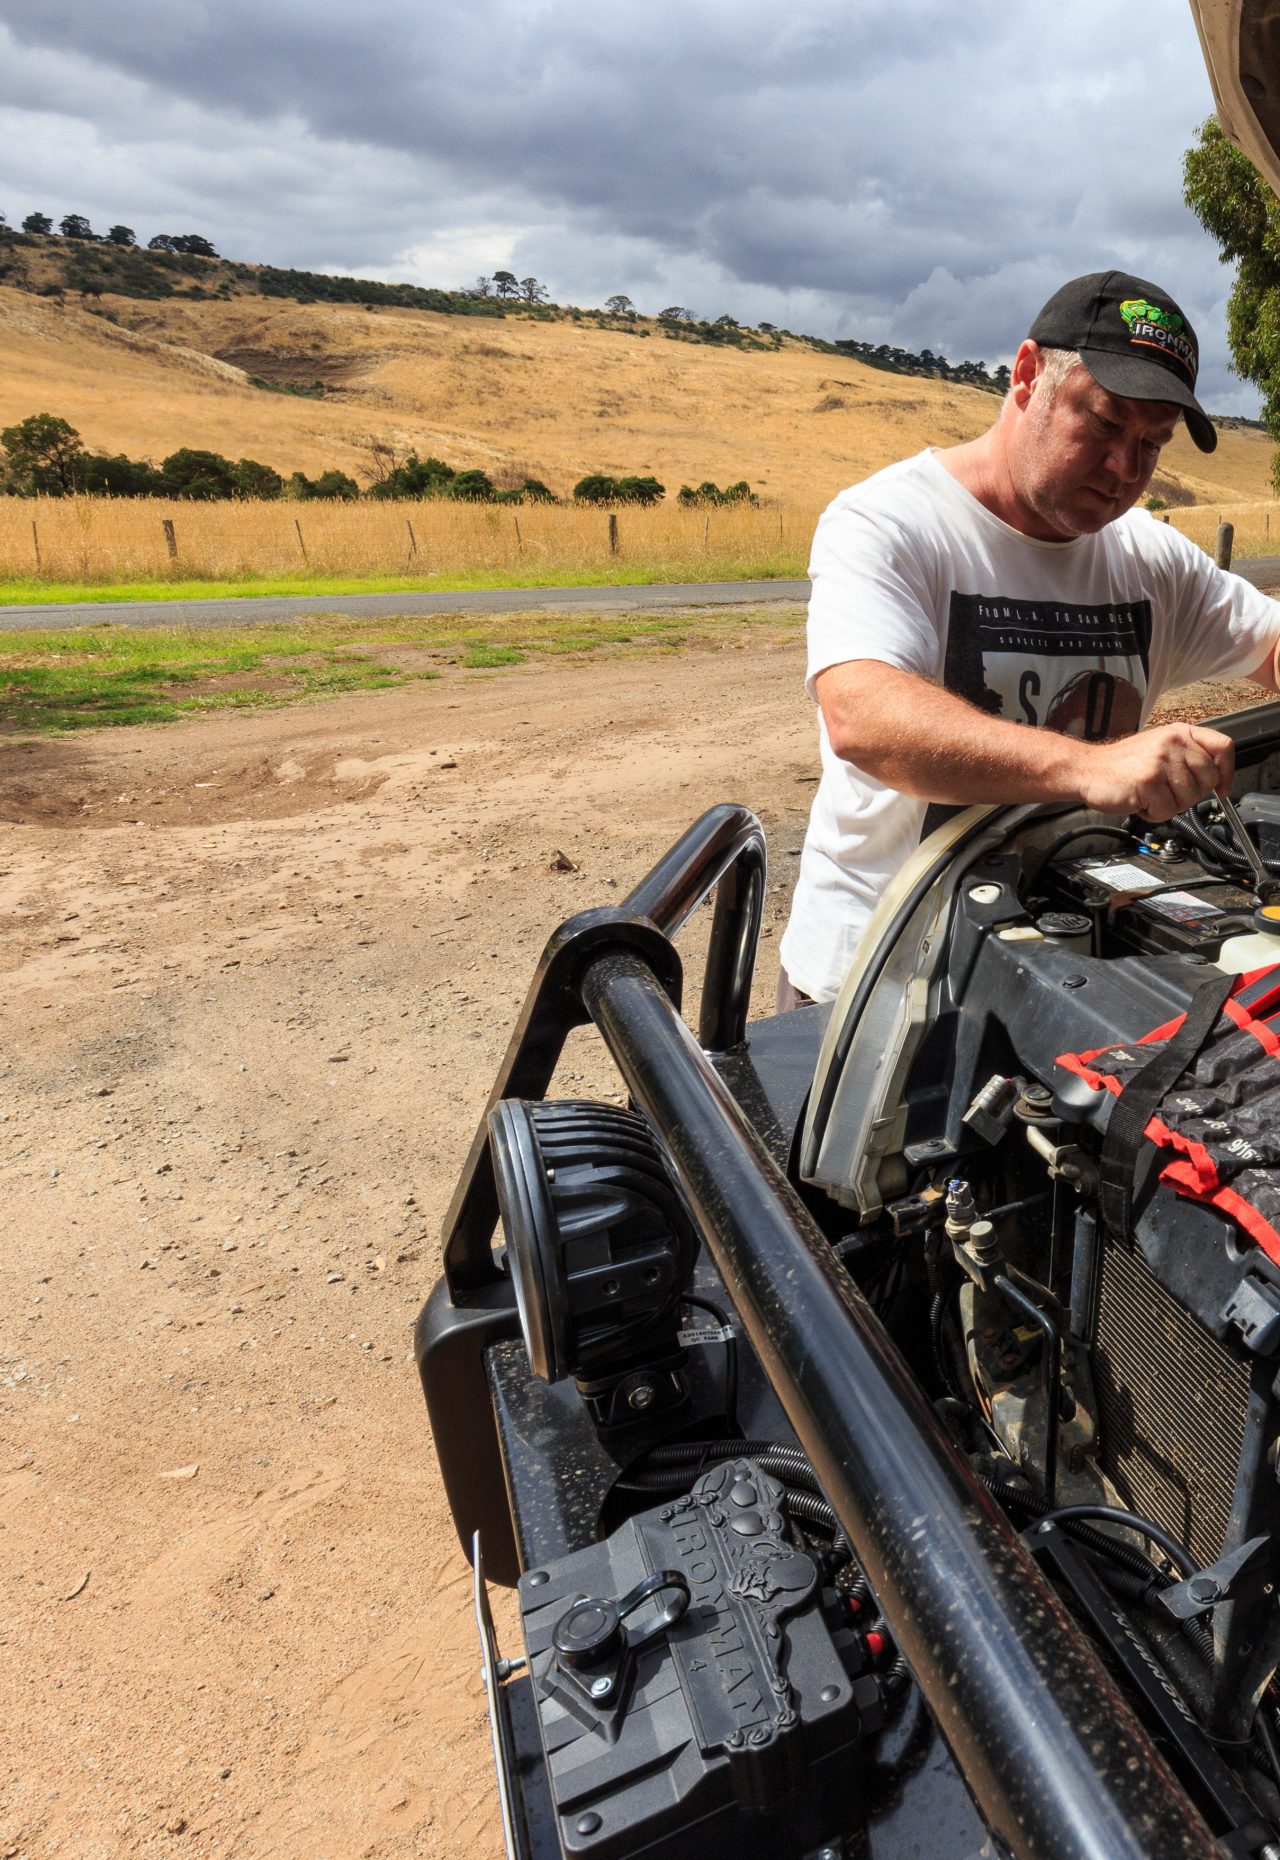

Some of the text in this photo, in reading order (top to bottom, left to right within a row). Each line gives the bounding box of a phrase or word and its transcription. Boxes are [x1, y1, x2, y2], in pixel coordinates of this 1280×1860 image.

[1055, 611, 1070, 623] TO
[1078, 614, 1099, 625] SAN
[1176, 1098, 1204, 1115] 3/4"
[1228, 1139, 1263, 1162] 9/16"
[669, 1511, 770, 1729] IRONMAN
[689, 1660, 707, 1673] 4
